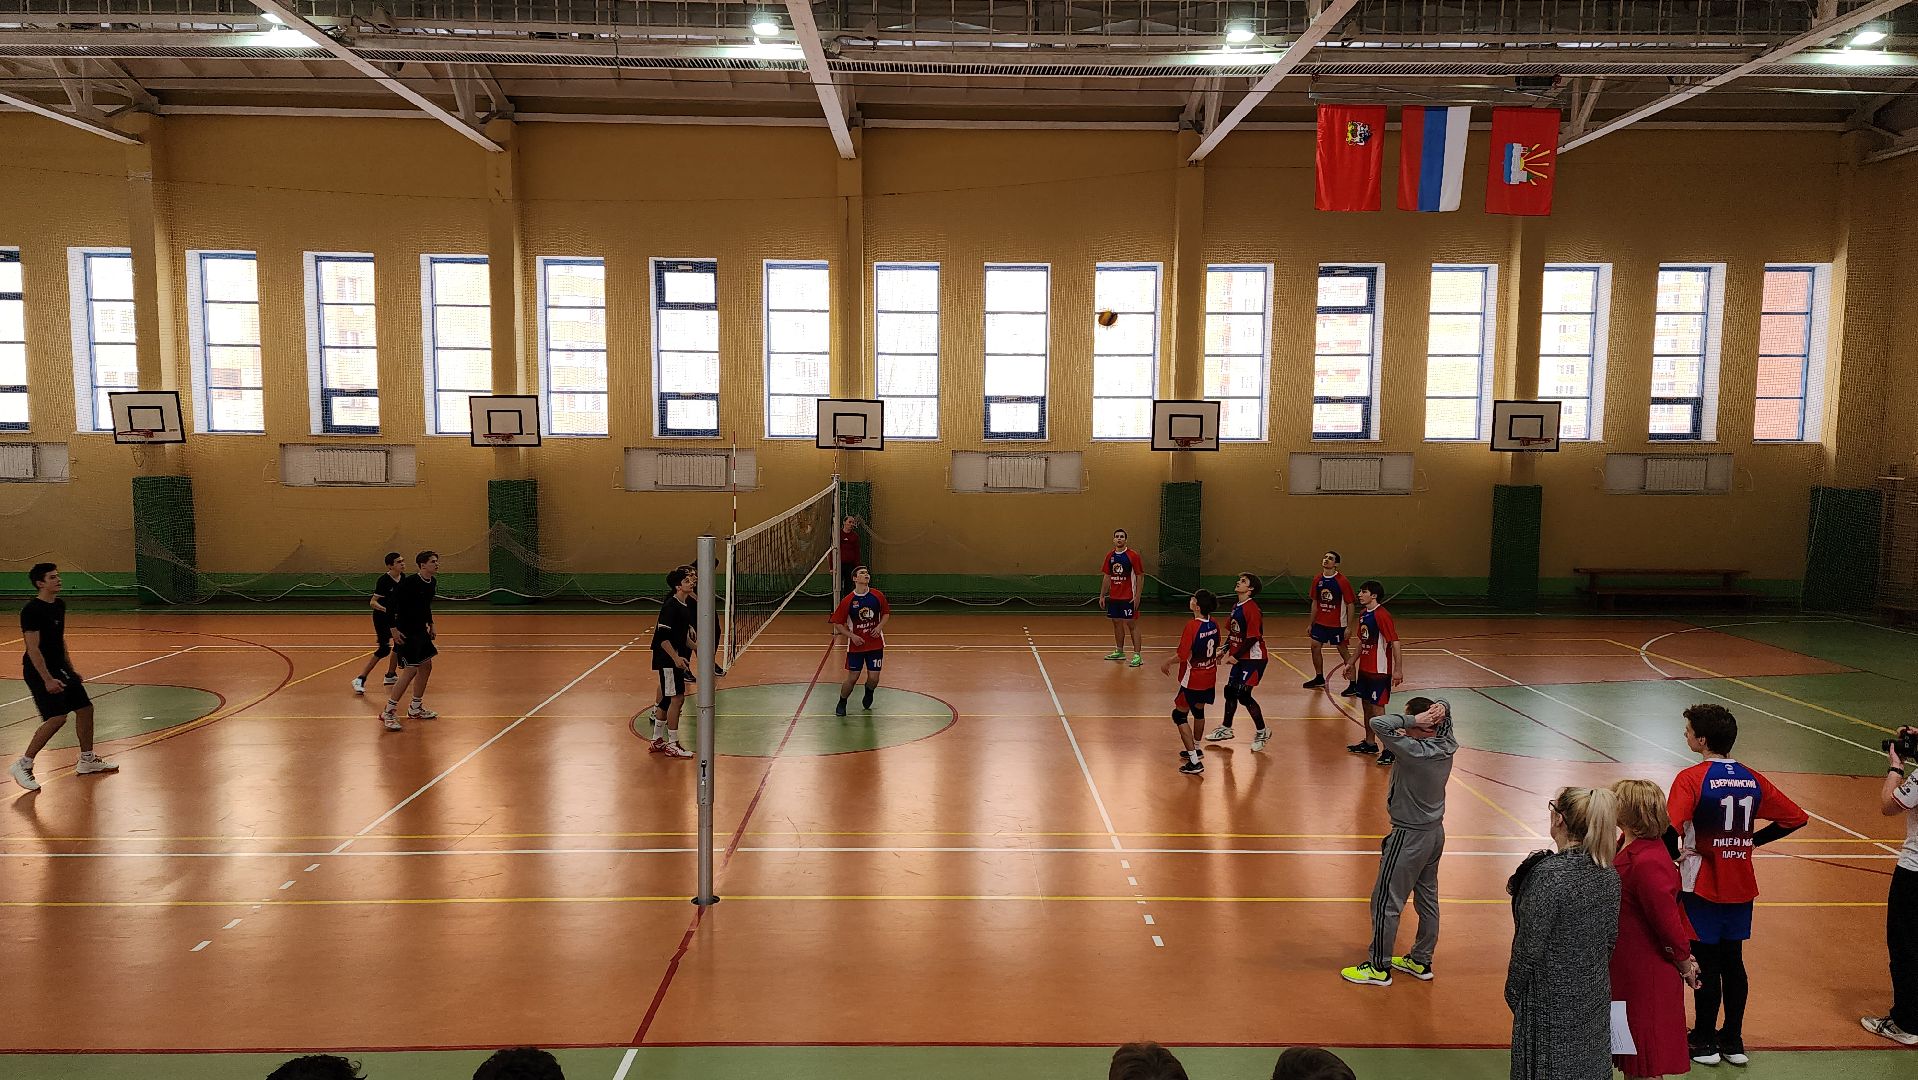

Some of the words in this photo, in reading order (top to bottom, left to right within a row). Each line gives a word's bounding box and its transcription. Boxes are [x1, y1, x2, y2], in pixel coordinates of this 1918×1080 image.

[1206, 638, 1215, 658] 8
[872, 659, 882, 668] 10
[1242, 670, 1248, 680] 7
[1371, 690, 1377, 701] 4
[1720, 795, 1753, 832] 11
[1712, 837, 1741, 847] ЛИЦЕЙ
[1722, 850, 1747, 860] ПАРУС
